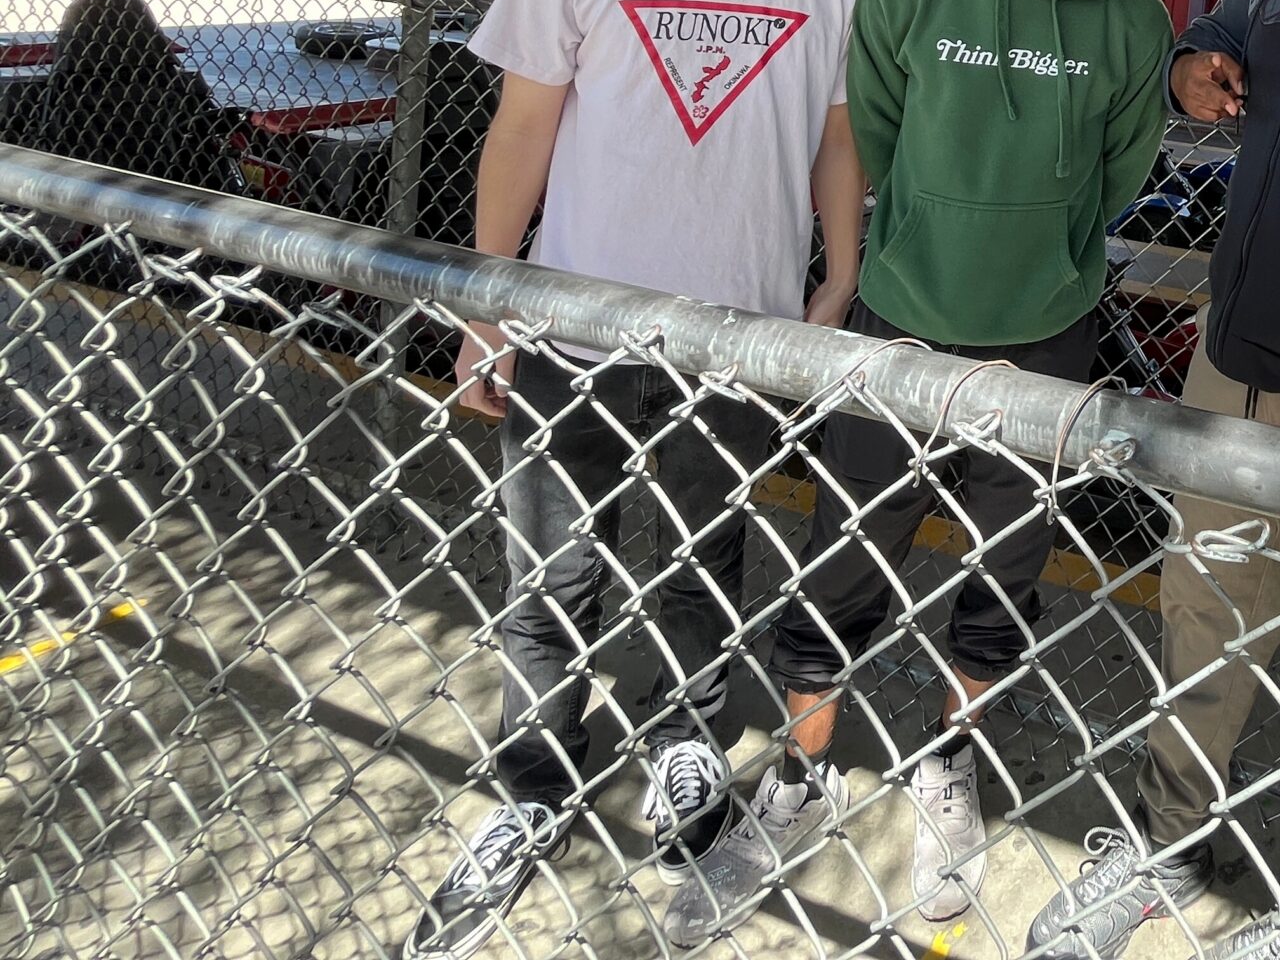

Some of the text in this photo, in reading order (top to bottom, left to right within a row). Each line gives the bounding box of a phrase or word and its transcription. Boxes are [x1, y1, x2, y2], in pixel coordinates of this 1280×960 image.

[653, 11, 772, 46] RUNOKI
[936, 38, 999, 67] Thin
[663, 57, 688, 92] REPRESENT
[723, 64, 751, 90] OKINAWA
